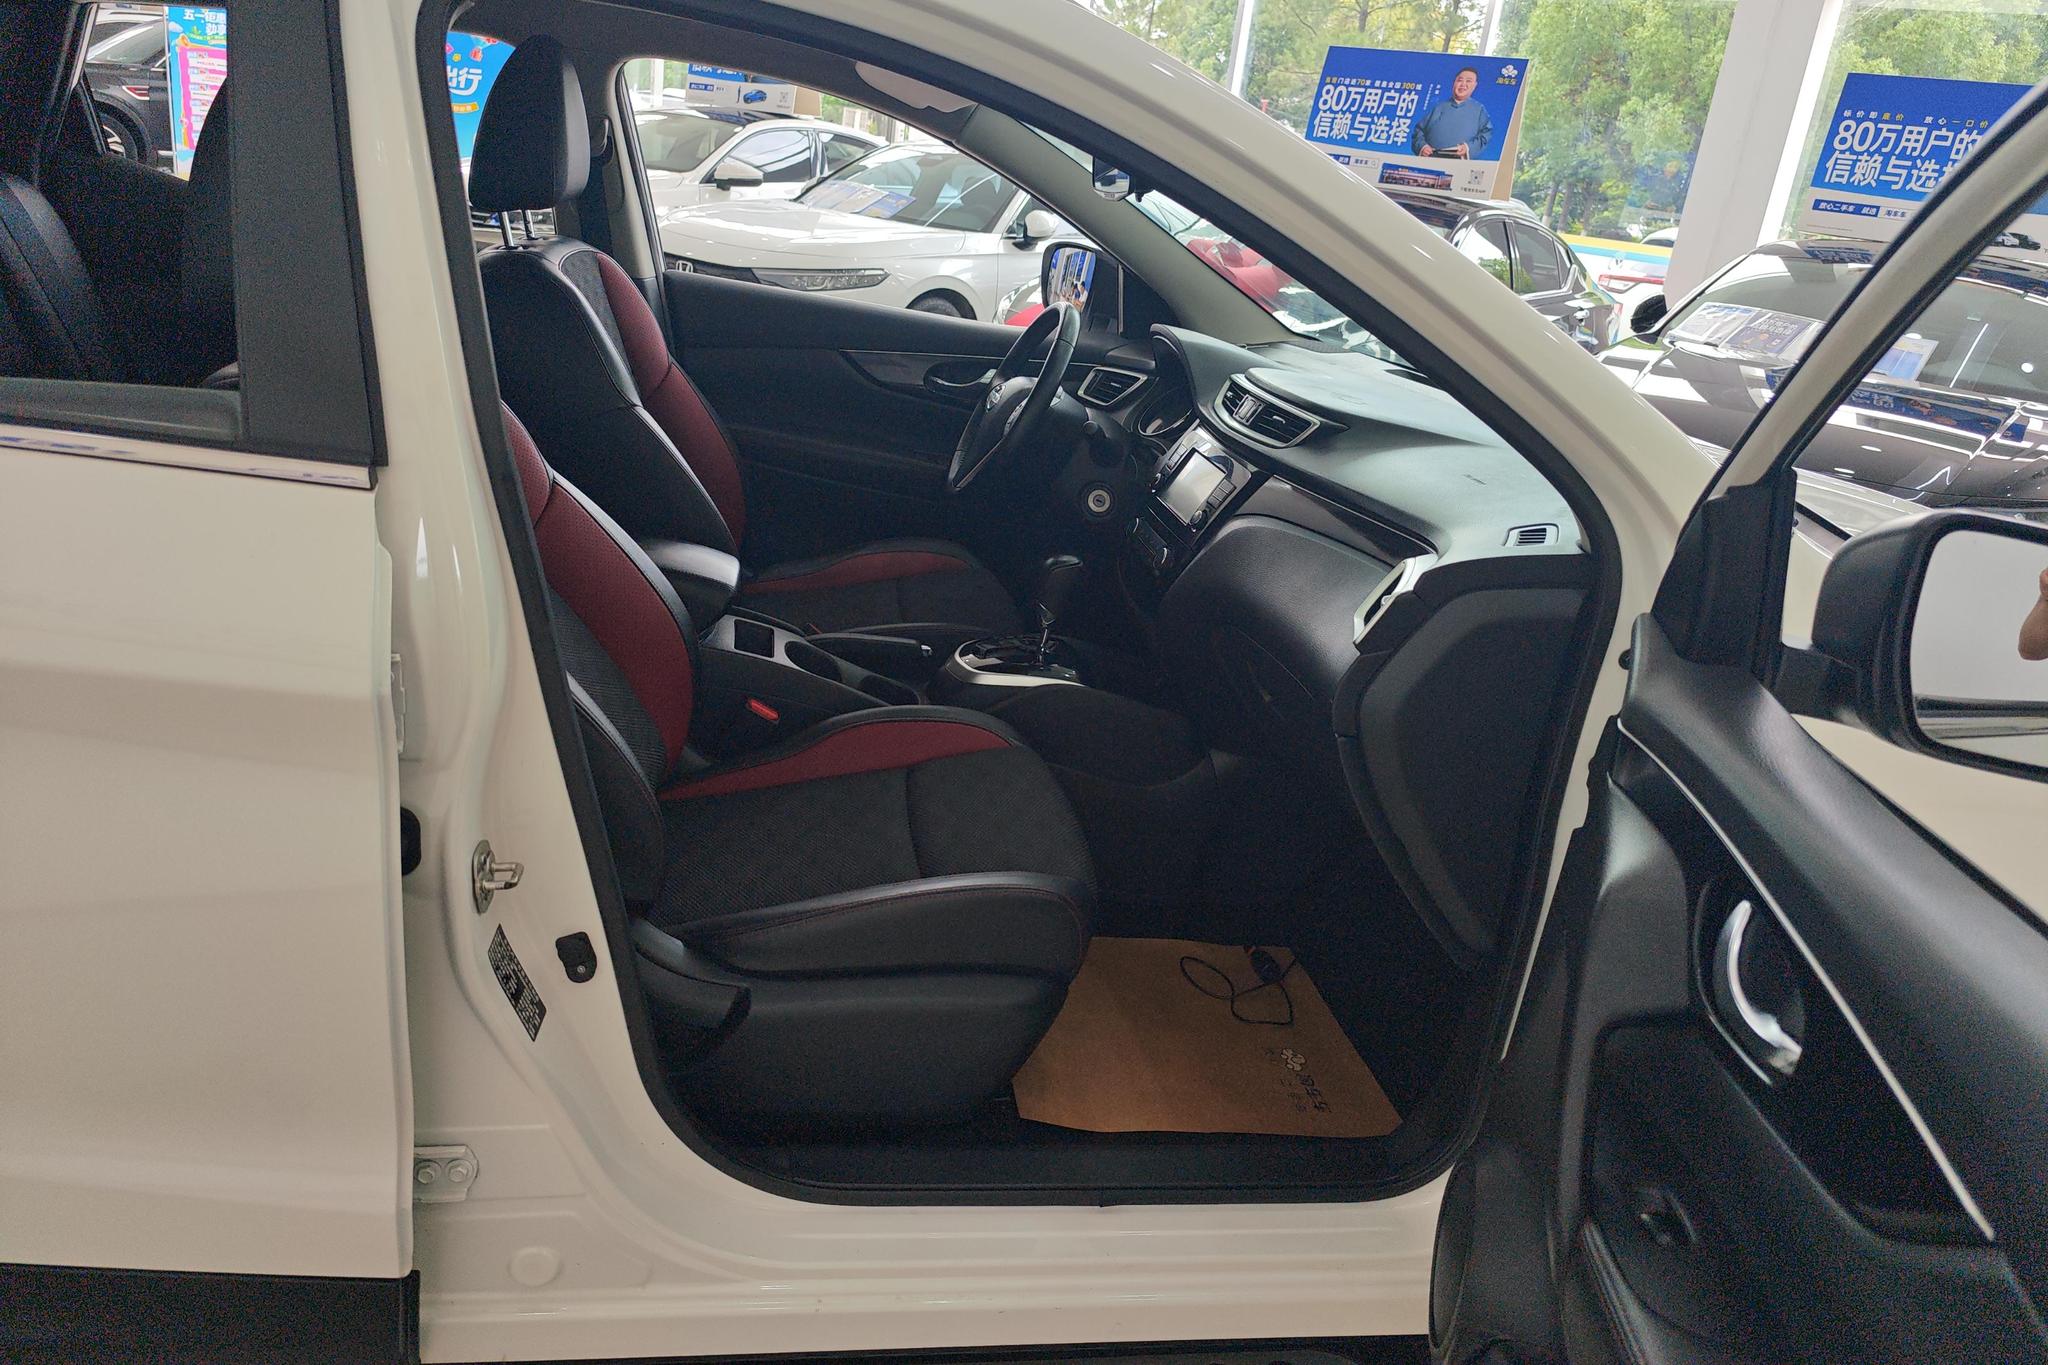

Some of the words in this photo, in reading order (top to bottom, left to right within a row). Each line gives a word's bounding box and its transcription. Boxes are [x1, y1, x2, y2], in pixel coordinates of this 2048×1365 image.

[1318, 83, 1419, 118] 80万用户的
[1313, 110, 1412, 146] 信赖与选择
[1833, 119, 1982, 162] 80万用户的
